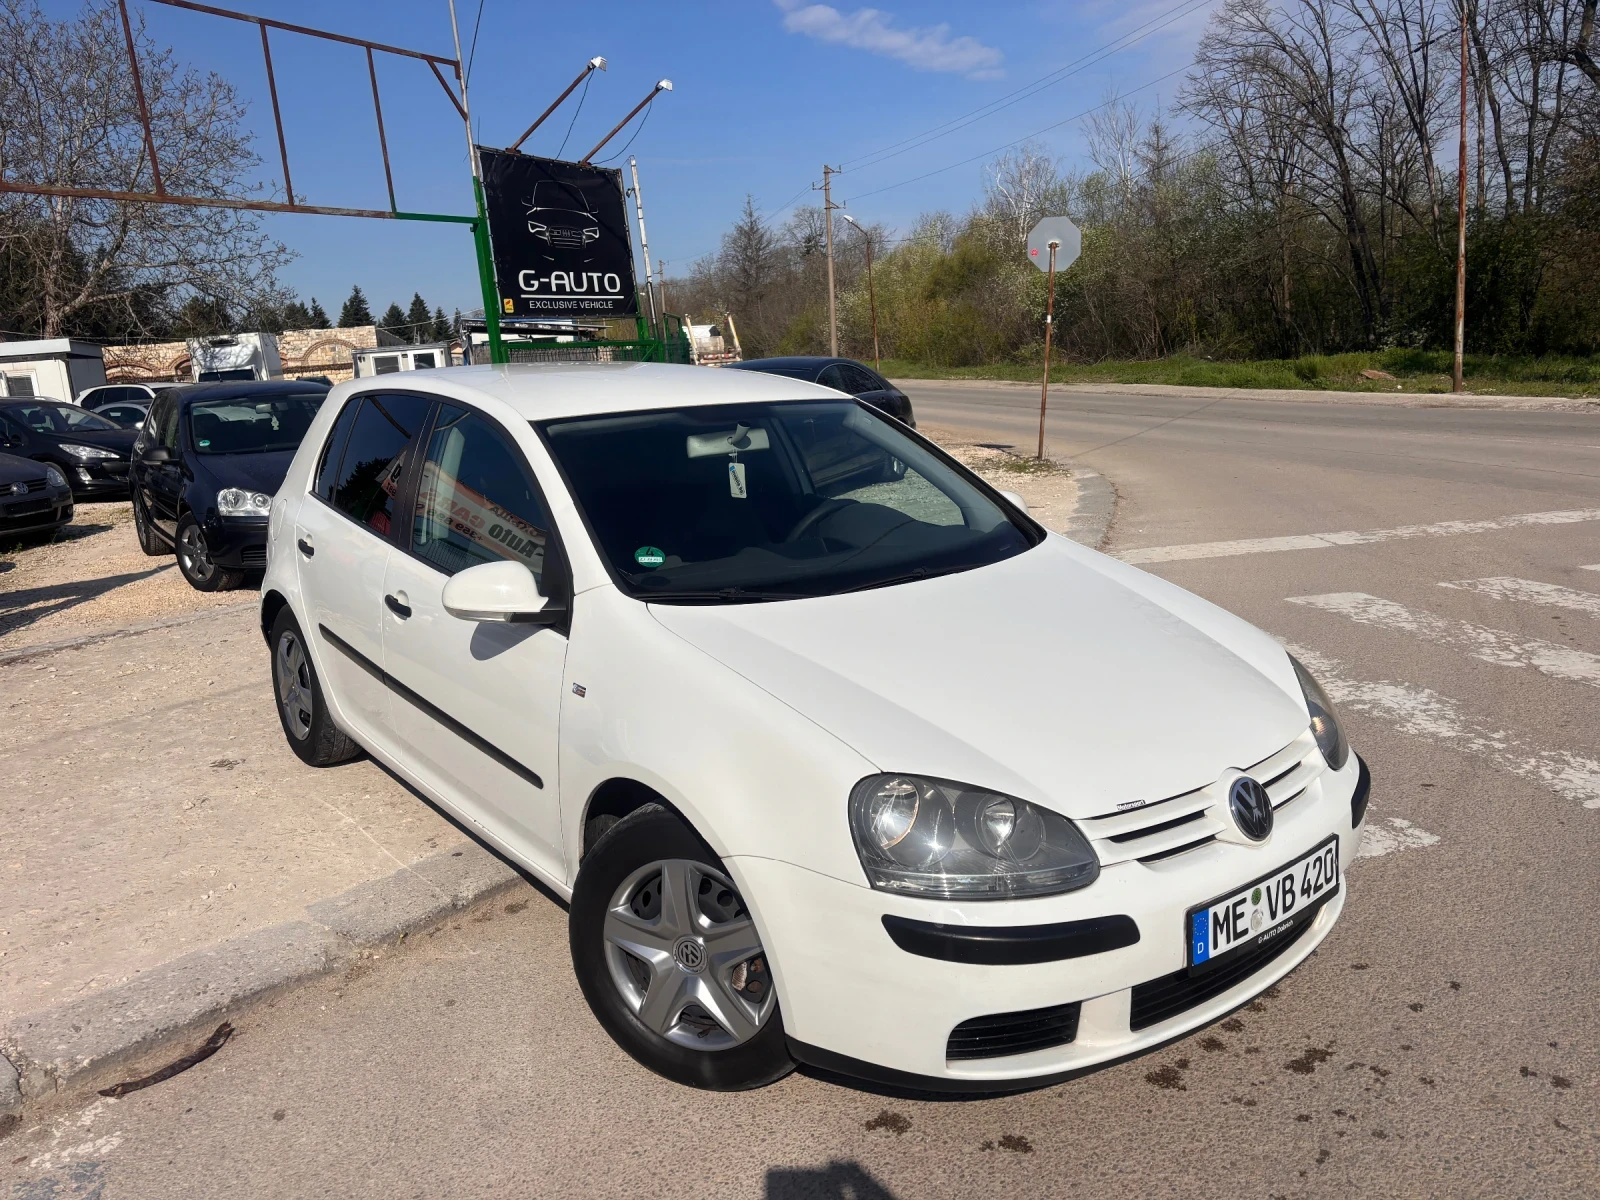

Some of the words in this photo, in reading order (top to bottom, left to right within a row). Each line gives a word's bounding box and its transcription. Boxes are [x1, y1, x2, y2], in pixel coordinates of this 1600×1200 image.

[518, 269, 621, 293] G-AUTO
[529, 300, 578, 309] EXCLUSIVE
[579, 300, 614, 309] VEHICLE
[1197, 941, 1204, 955] D
[1212, 897, 1249, 951] ME
[1266, 873, 1296, 921] VB
[1300, 847, 1335, 900] 420
